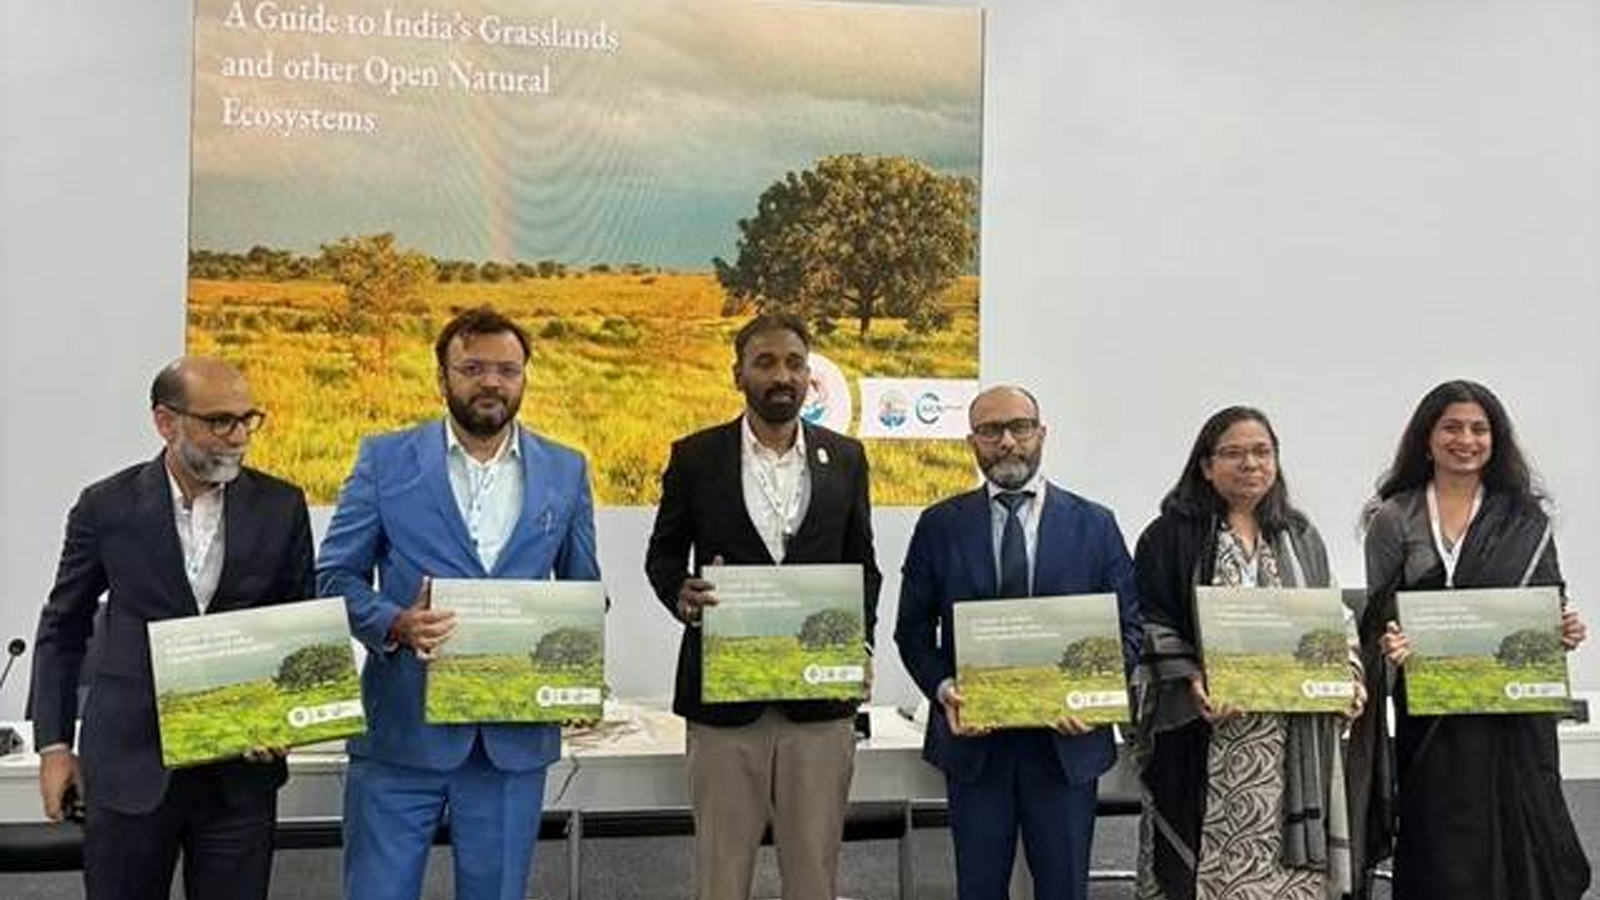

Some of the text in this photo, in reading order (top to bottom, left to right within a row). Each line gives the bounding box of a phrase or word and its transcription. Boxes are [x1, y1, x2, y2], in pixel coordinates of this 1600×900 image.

[224, 1, 247, 29] A
[255, 2, 337, 33] Guide
[348, 12, 376, 37] to
[480, 15, 619, 52] Grasslands
[222, 51, 551, 95] and other Open Natural
[223, 98, 377, 136] Ecosystems
